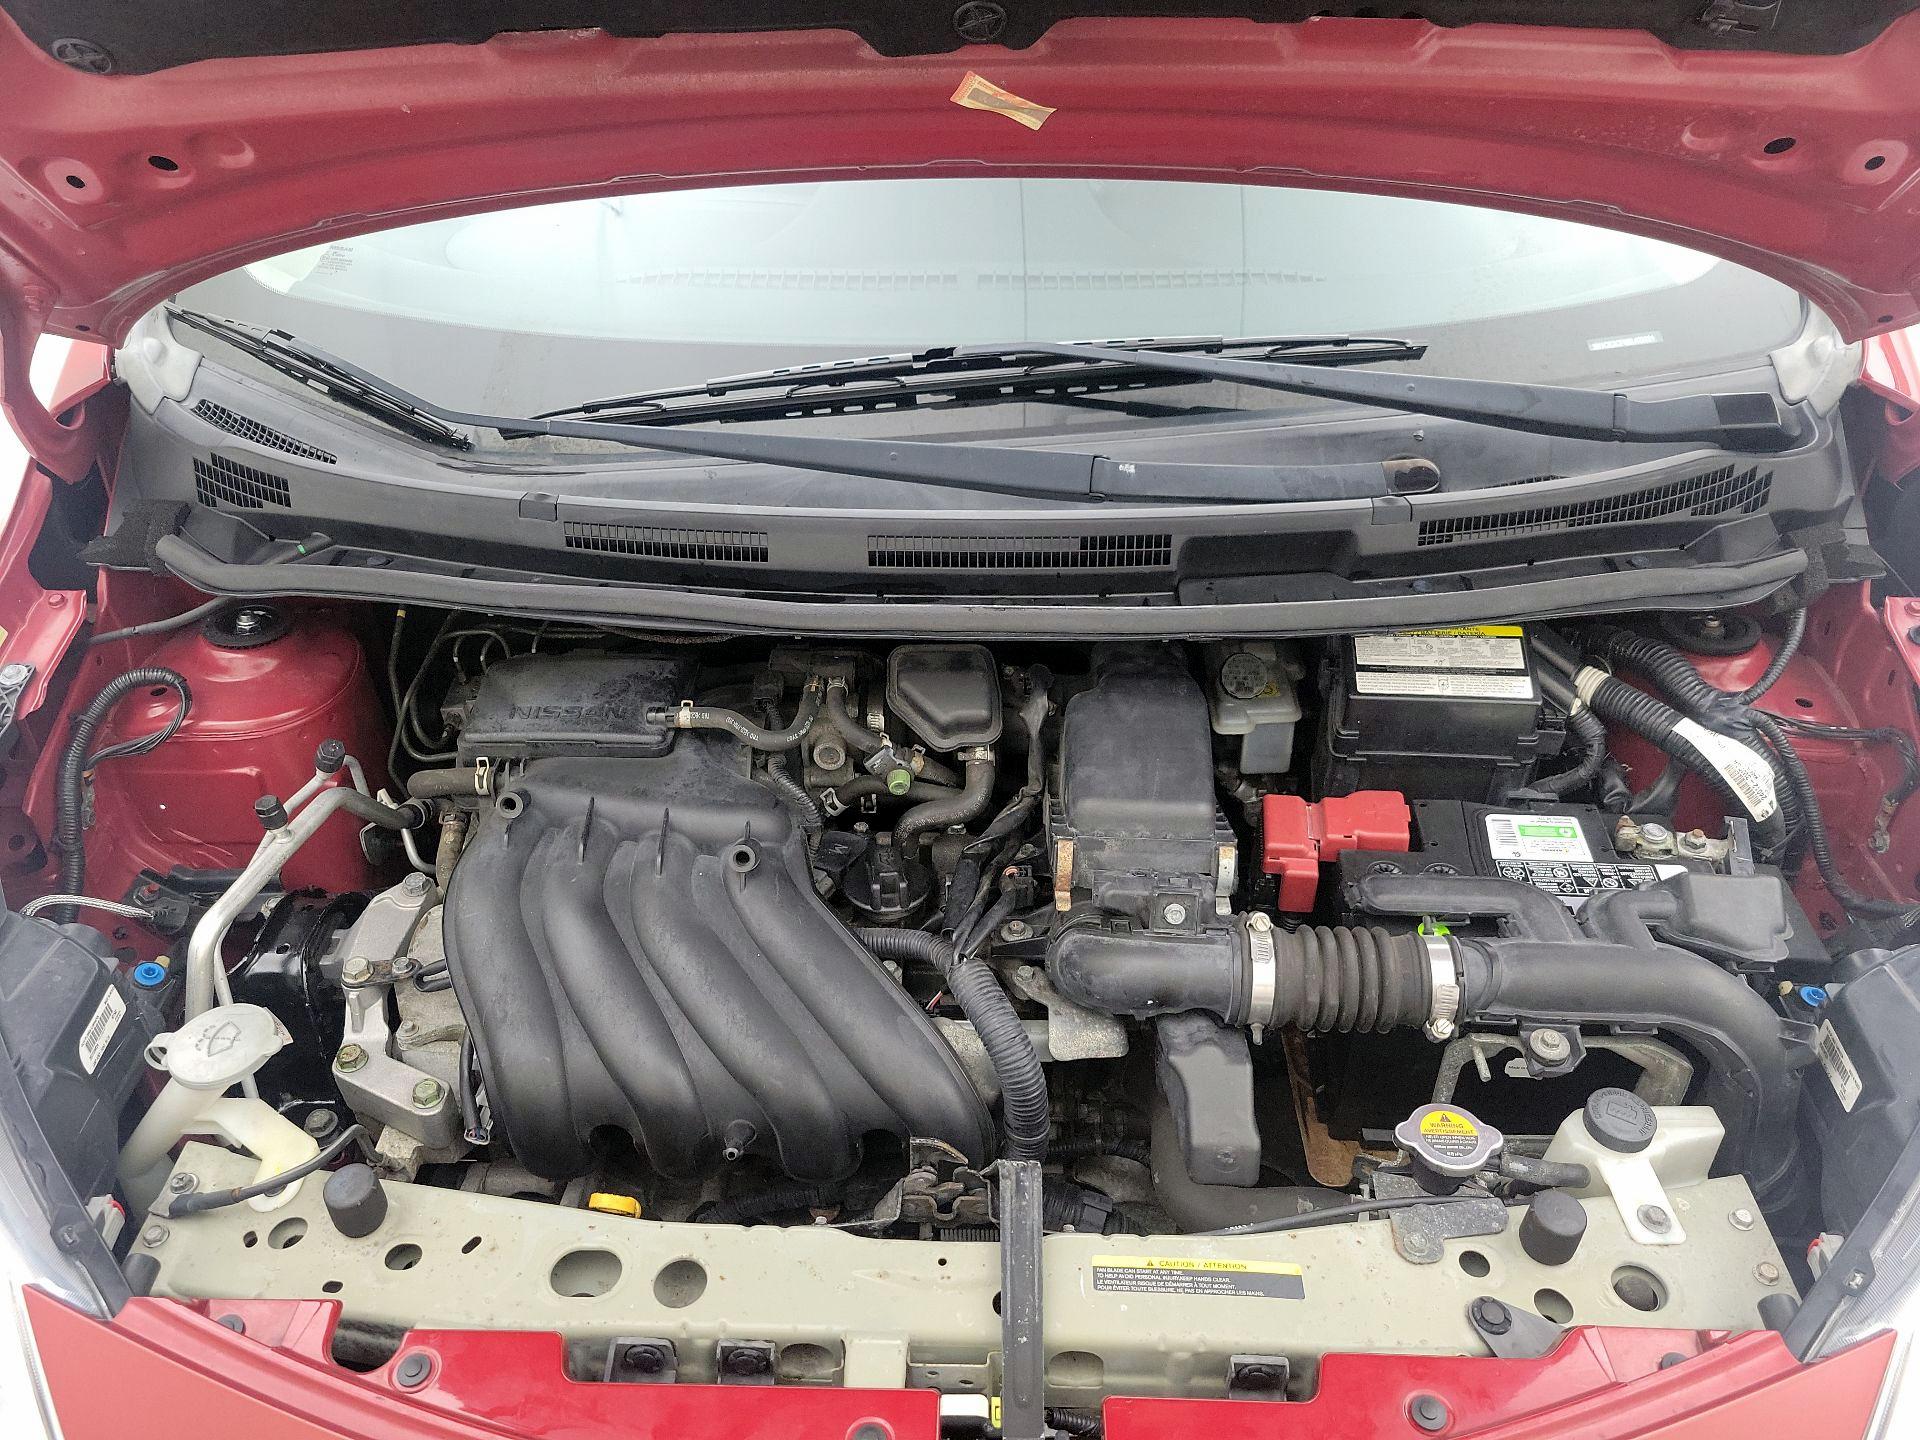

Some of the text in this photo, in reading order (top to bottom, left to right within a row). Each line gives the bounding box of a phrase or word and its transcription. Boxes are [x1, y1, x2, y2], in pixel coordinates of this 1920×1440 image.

[508, 704, 627, 720] NISSAN
[1159, 1260, 1195, 1268] CAUTION
[1203, 1262, 1247, 1270] ATTENTION
